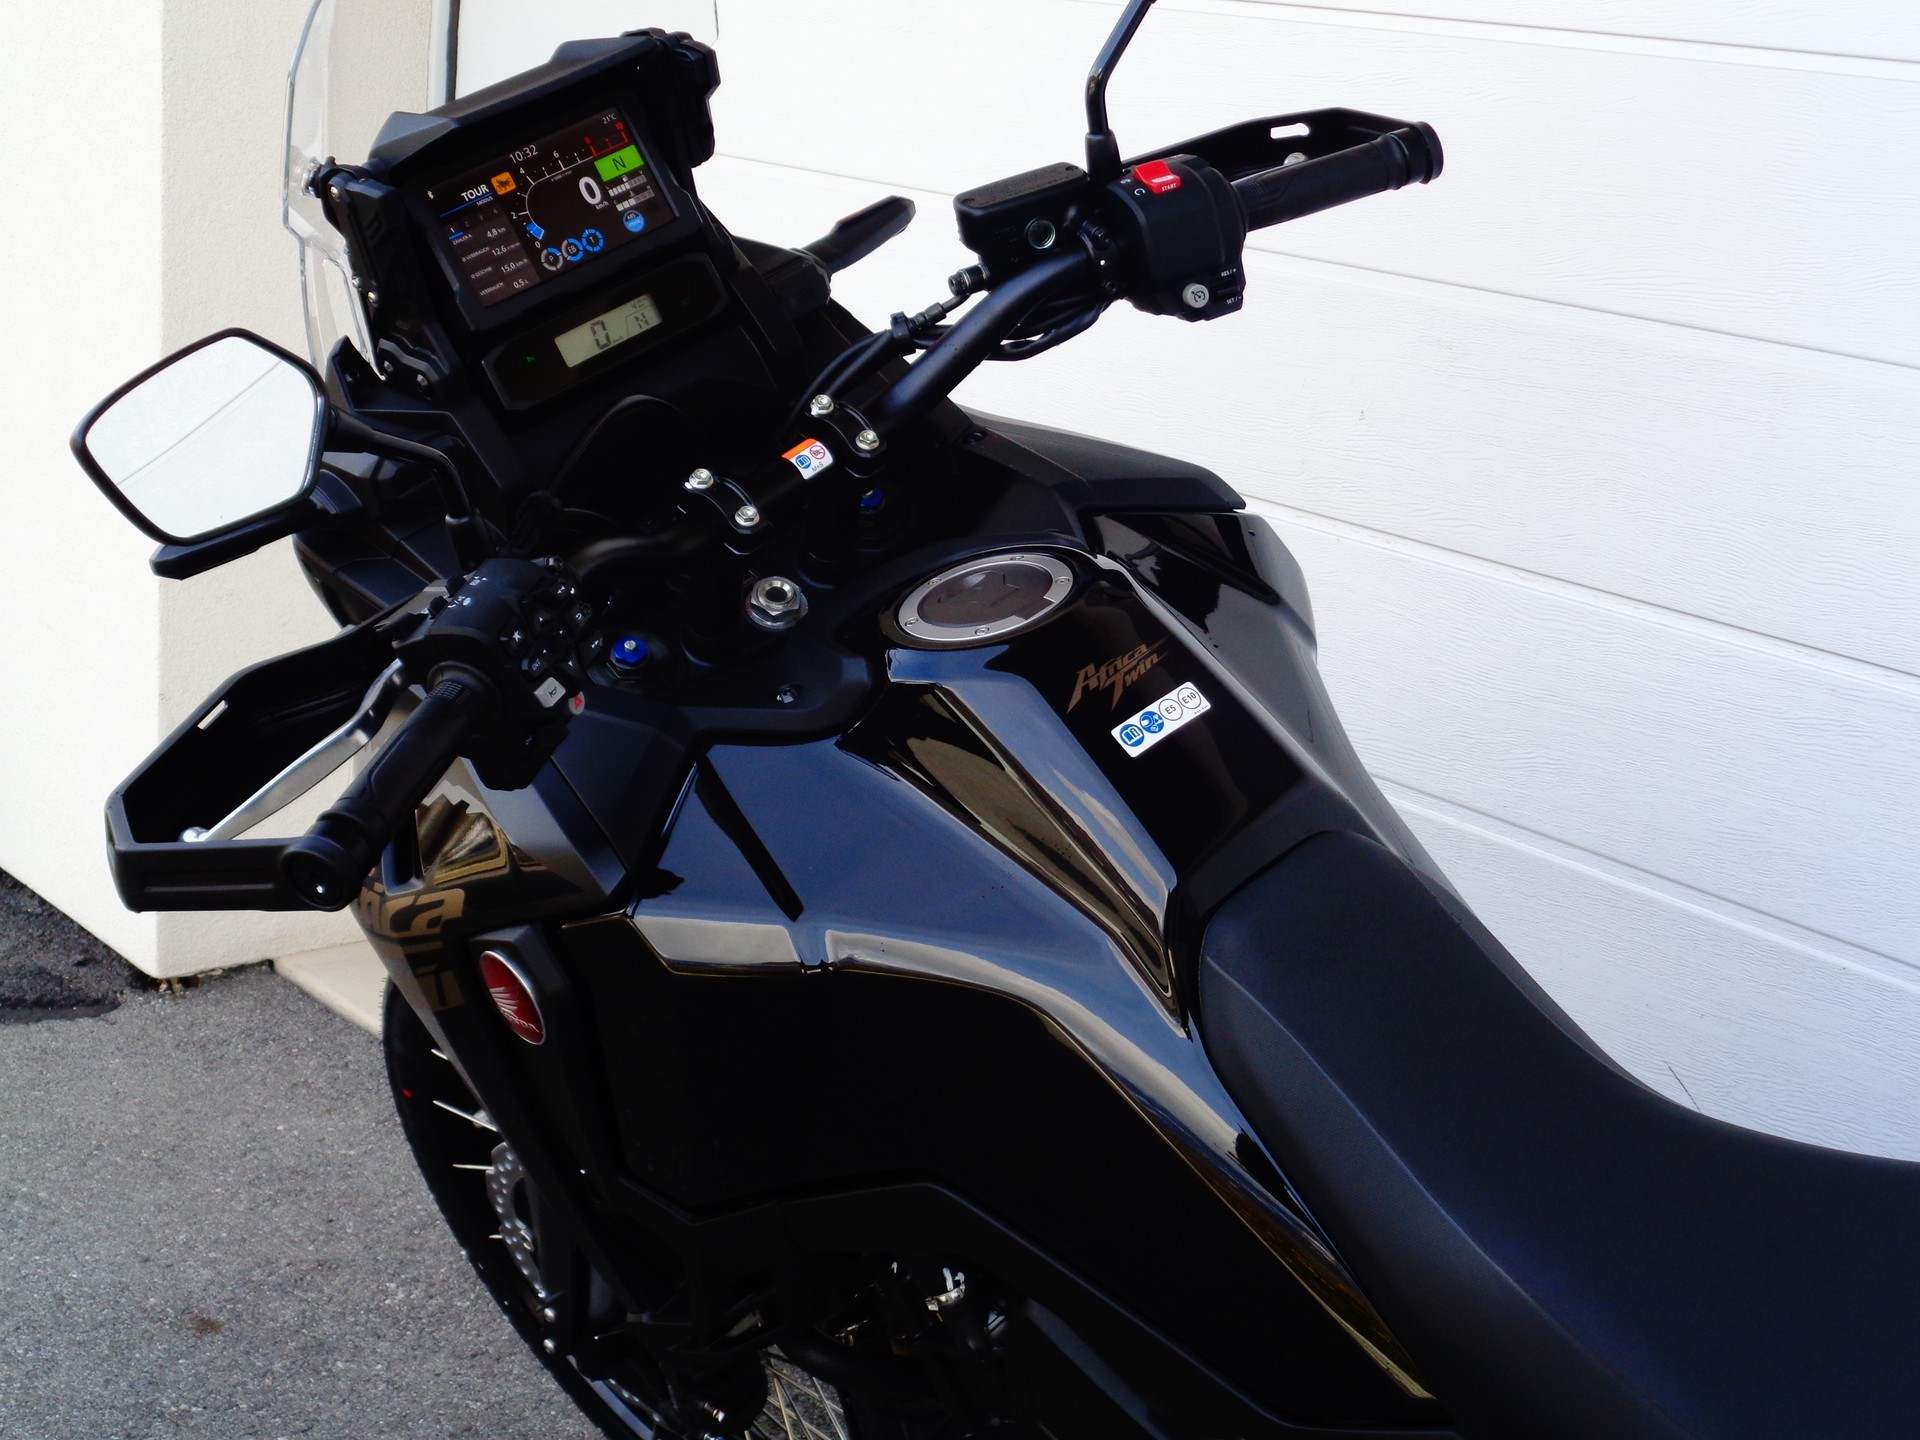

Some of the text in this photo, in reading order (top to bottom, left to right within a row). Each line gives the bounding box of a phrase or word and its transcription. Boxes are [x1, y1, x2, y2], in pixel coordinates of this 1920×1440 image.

[509, 144, 539, 164] 10:32
[552, 150, 559, 158] 6
[612, 155, 627, 172] N
[519, 167, 526, 175] 4
[578, 176, 602, 205] 0
[1161, 182, 1177, 192] START
[461, 184, 489, 202] TOUR
[476, 196, 494, 206] MODUS
[595, 200, 610, 210] km/h
[486, 228, 498, 239] 4,8
[534, 240, 542, 249] 0
[567, 245, 577, 254] EB
[491, 245, 507, 257] 12,6
[500, 262, 516, 273] 15,0
[513, 279, 524, 289] 0,5
[590, 319, 612, 350] 0
[811, 462, 825, 474] M+S
[1067, 640, 1156, 713] Africa
[1101, 654, 1163, 712] Twin
[1165, 692, 1197, 715] E5 E10
